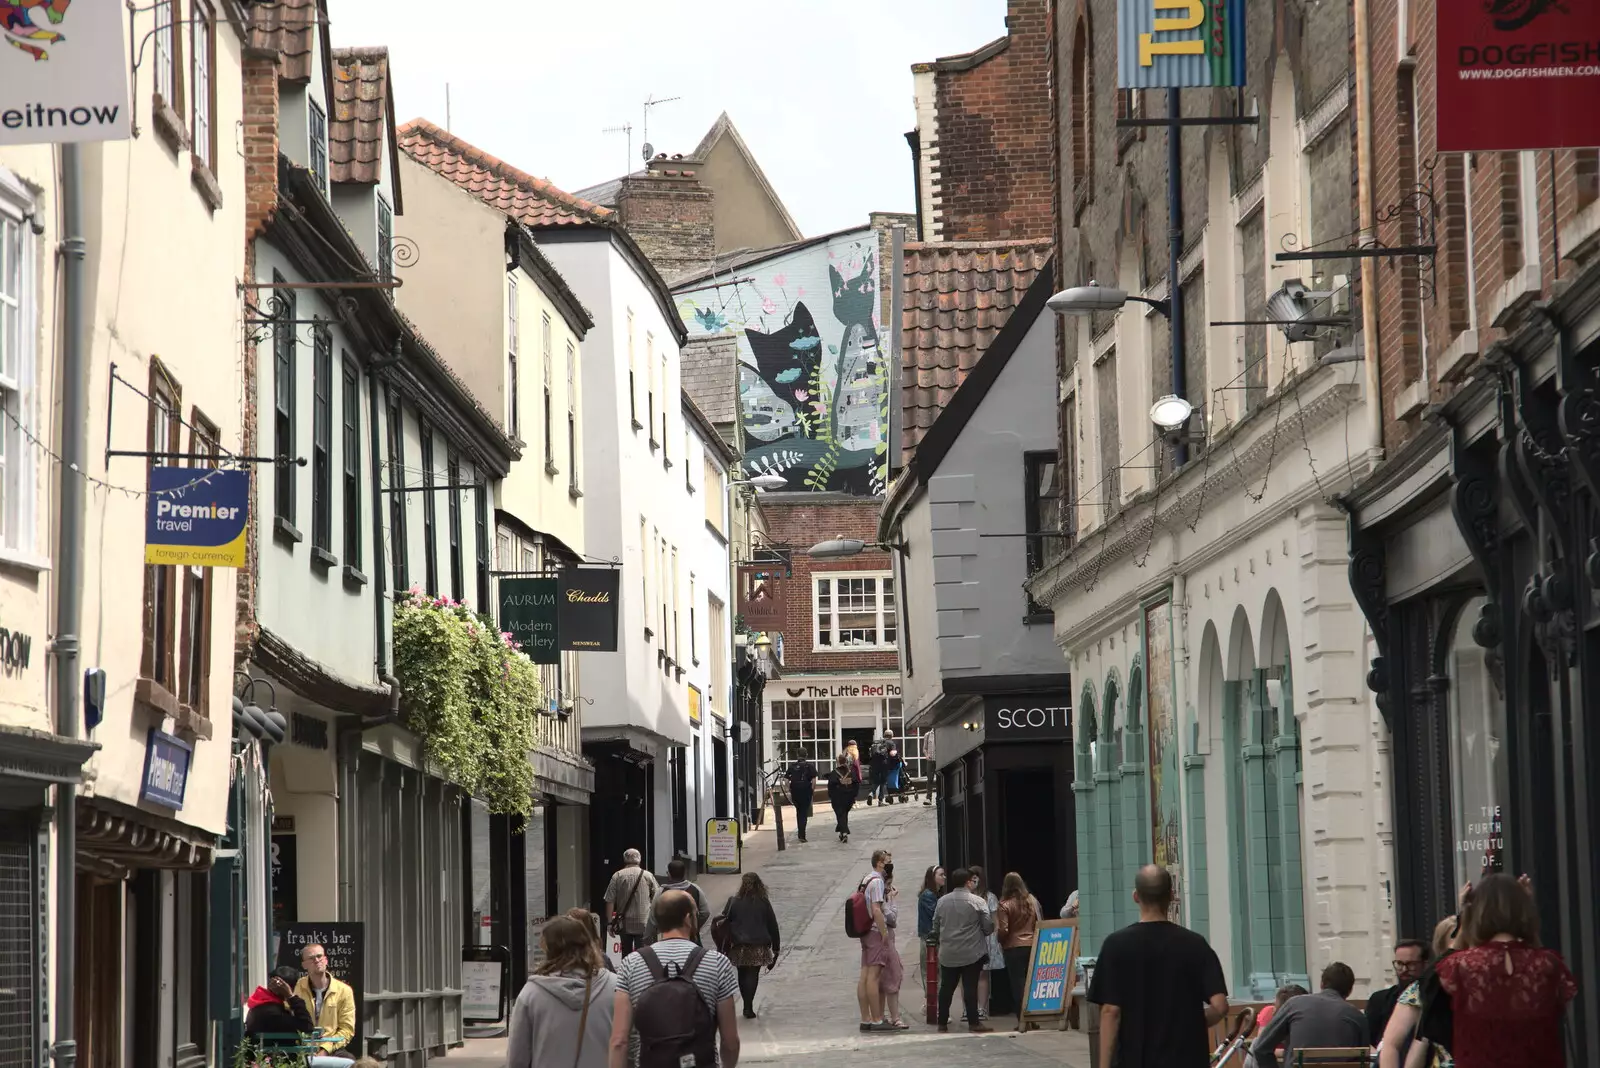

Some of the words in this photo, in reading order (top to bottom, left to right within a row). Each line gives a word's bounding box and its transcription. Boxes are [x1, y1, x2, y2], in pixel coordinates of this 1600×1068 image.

[1459, 42, 1600, 66] DOGFISH
[2, 104, 119, 129] eitnow
[157, 500, 239, 520] Premier
[156, 518, 192, 531] travel
[156, 549, 190, 559] foreign
[192, 552, 235, 563] currency
[503, 593, 556, 607] AURUM
[566, 588, 610, 603] Chadds
[508, 620, 552, 632] Modern
[806, 686, 829, 698] The
[830, 685, 860, 697] Little
[861, 684, 884, 697] Red
[997, 706, 1072, 729] SCOTT
[1481, 805, 1501, 817] THE
[1468, 821, 1502, 835] FURTH
[1456, 838, 1504, 853] ADVENTU
[287, 930, 328, 944] frank's
[1038, 940, 1068, 966] RUM
[1033, 981, 1062, 999] JERK
